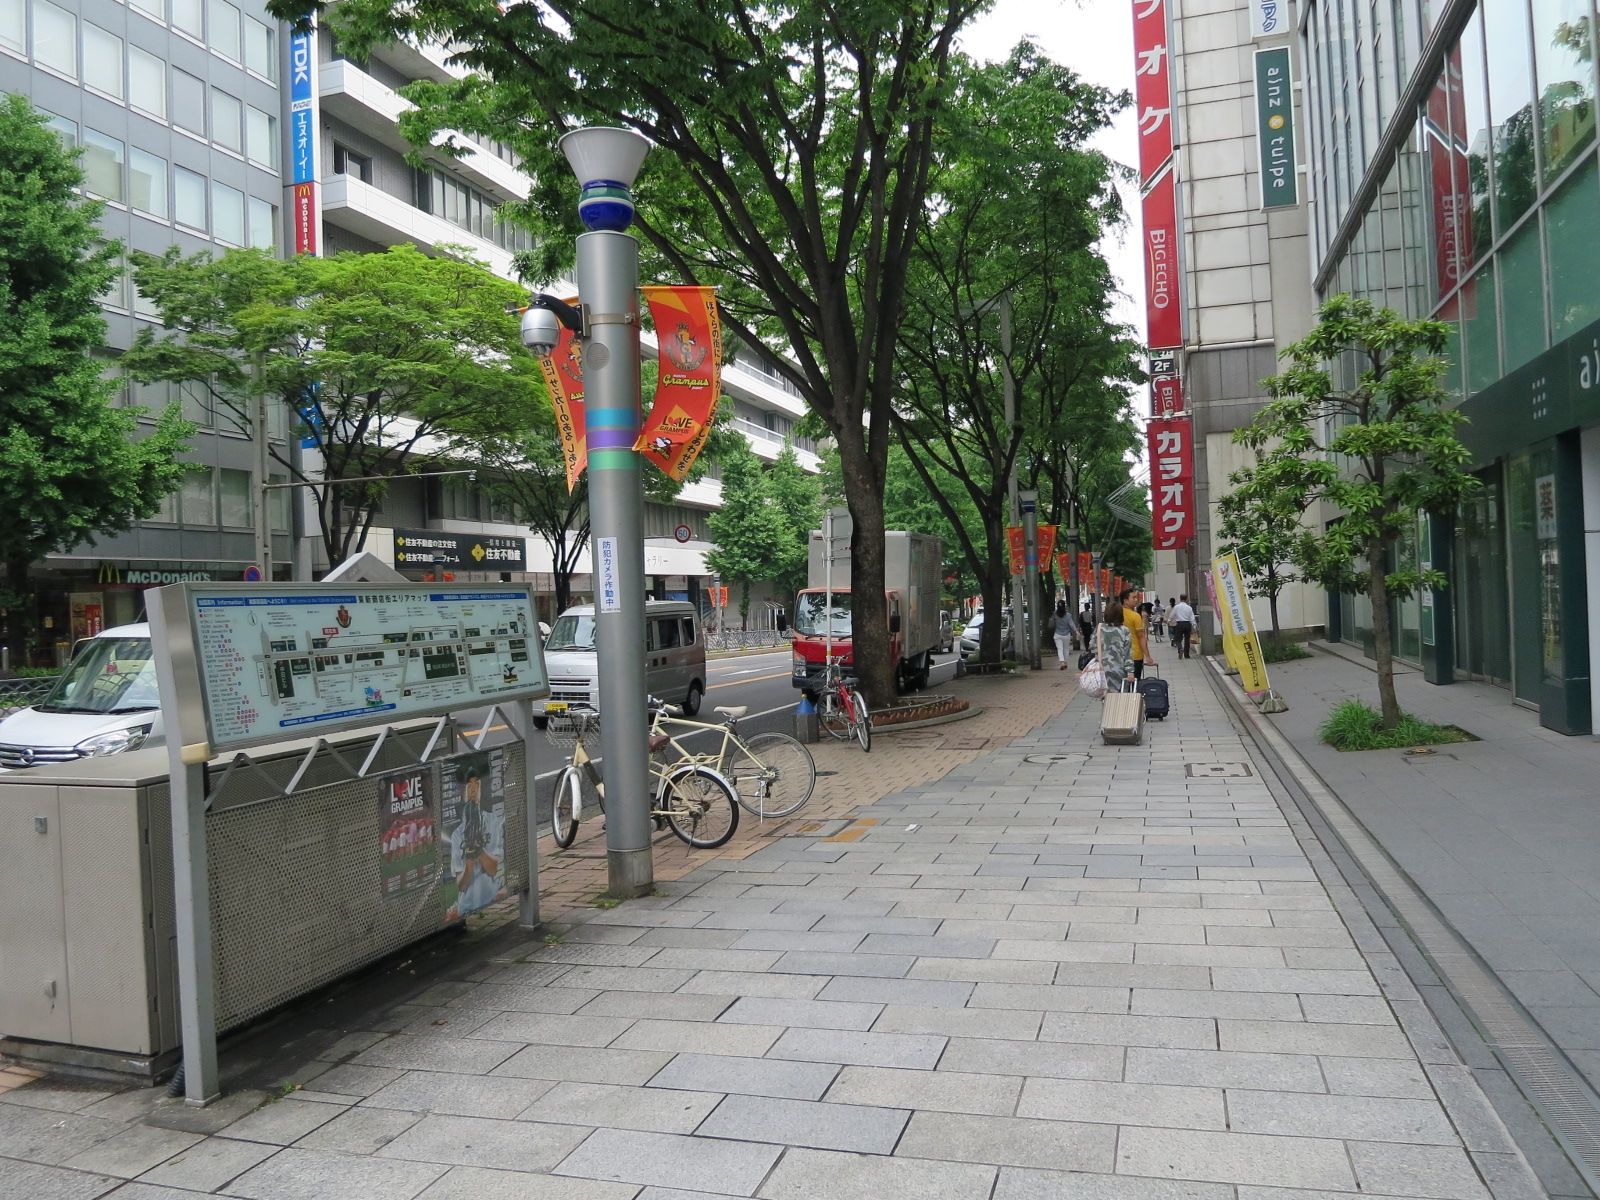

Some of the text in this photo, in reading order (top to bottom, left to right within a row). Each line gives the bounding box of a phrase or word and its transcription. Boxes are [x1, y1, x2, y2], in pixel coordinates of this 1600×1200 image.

[294, 36, 308, 85] TDK
[1268, 67, 1281, 108] ainz
[1270, 136, 1288, 187] tulpe
[1149, 228, 1169, 309] BIG ECHO
[1154, 361, 1170, 372] 2F
[662, 373, 709, 388] Grampus
[405, 538, 457, 549] 住友不動産の注文住宅
[486, 548, 521, 561] 住友不動産
[127, 571, 211, 584] McDonald's
[602, 540, 614, 607] 防犯カメラ作動中
[391, 796, 424, 814] GRAMPUS
